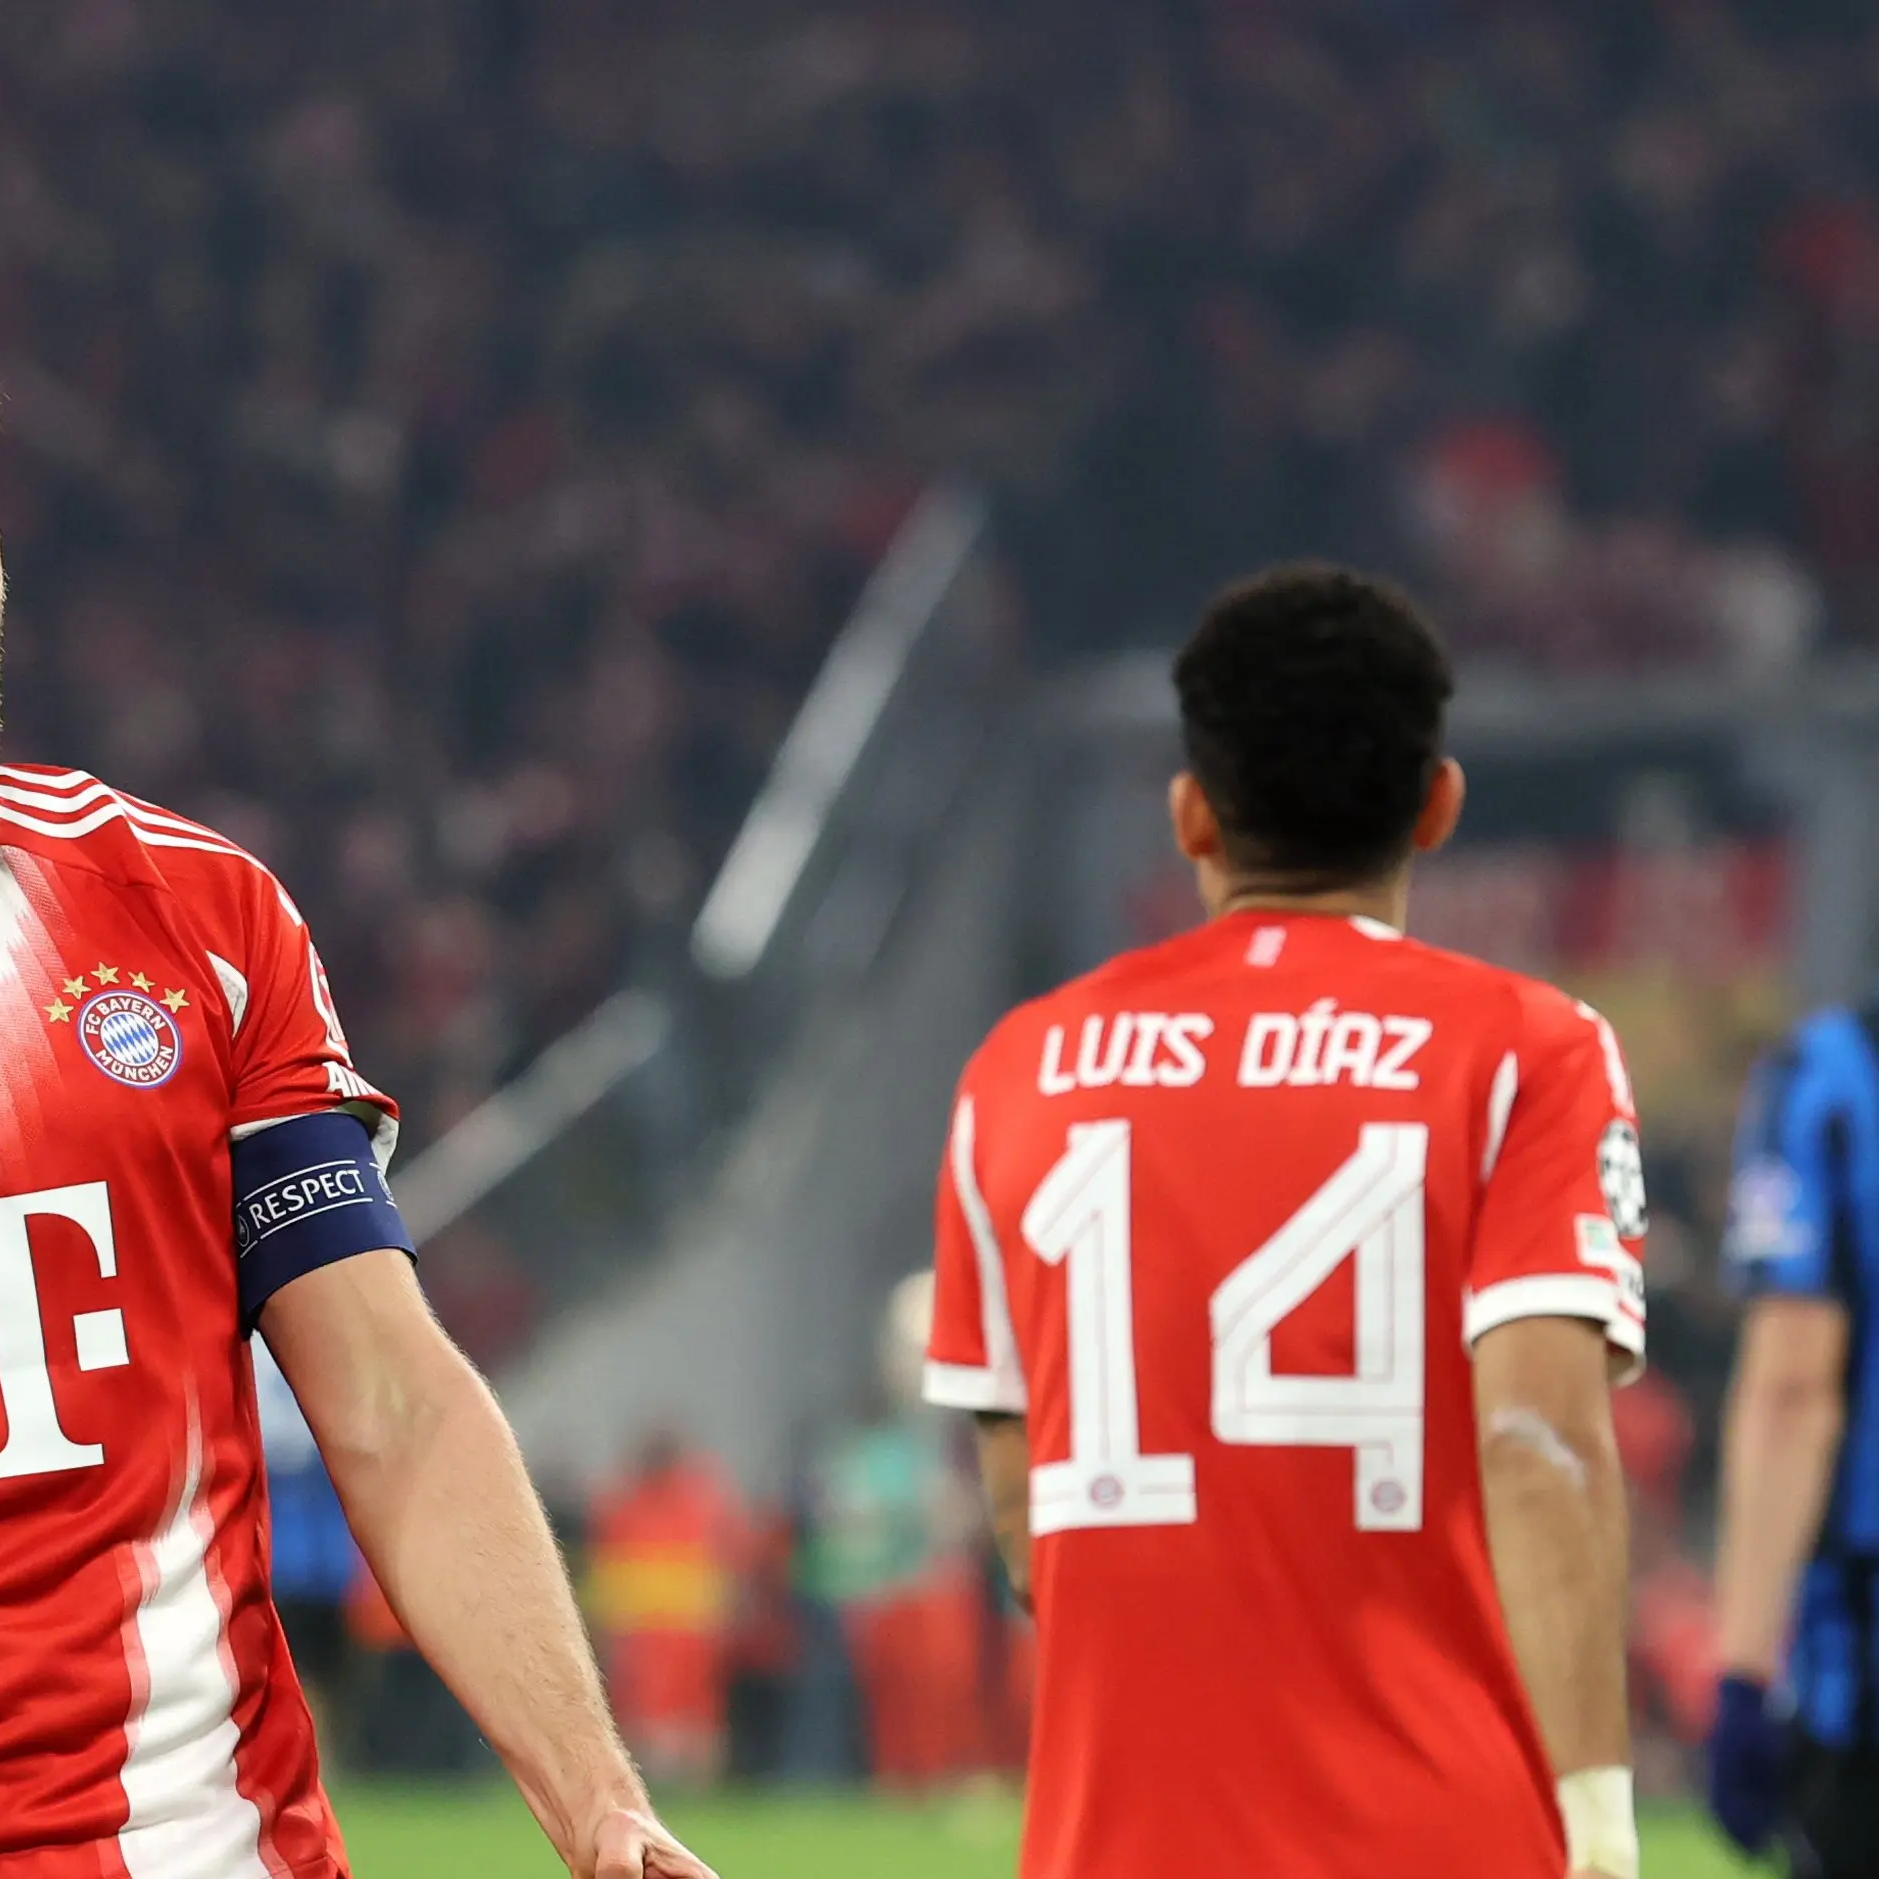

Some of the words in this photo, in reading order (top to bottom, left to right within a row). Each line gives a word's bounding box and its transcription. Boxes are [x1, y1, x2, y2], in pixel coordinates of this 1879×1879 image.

[85, 1013, 102, 1036] FC
[95, 997, 167, 1031] BAYERN
[1037, 1011, 1215, 1097] LUIS
[1237, 996, 1433, 1090] DÍAZ
[95, 1045, 174, 1081] MÜNCHEN
[248, 1169, 365, 1229] RESPECT
[1022, 1117, 1429, 1536] 14
